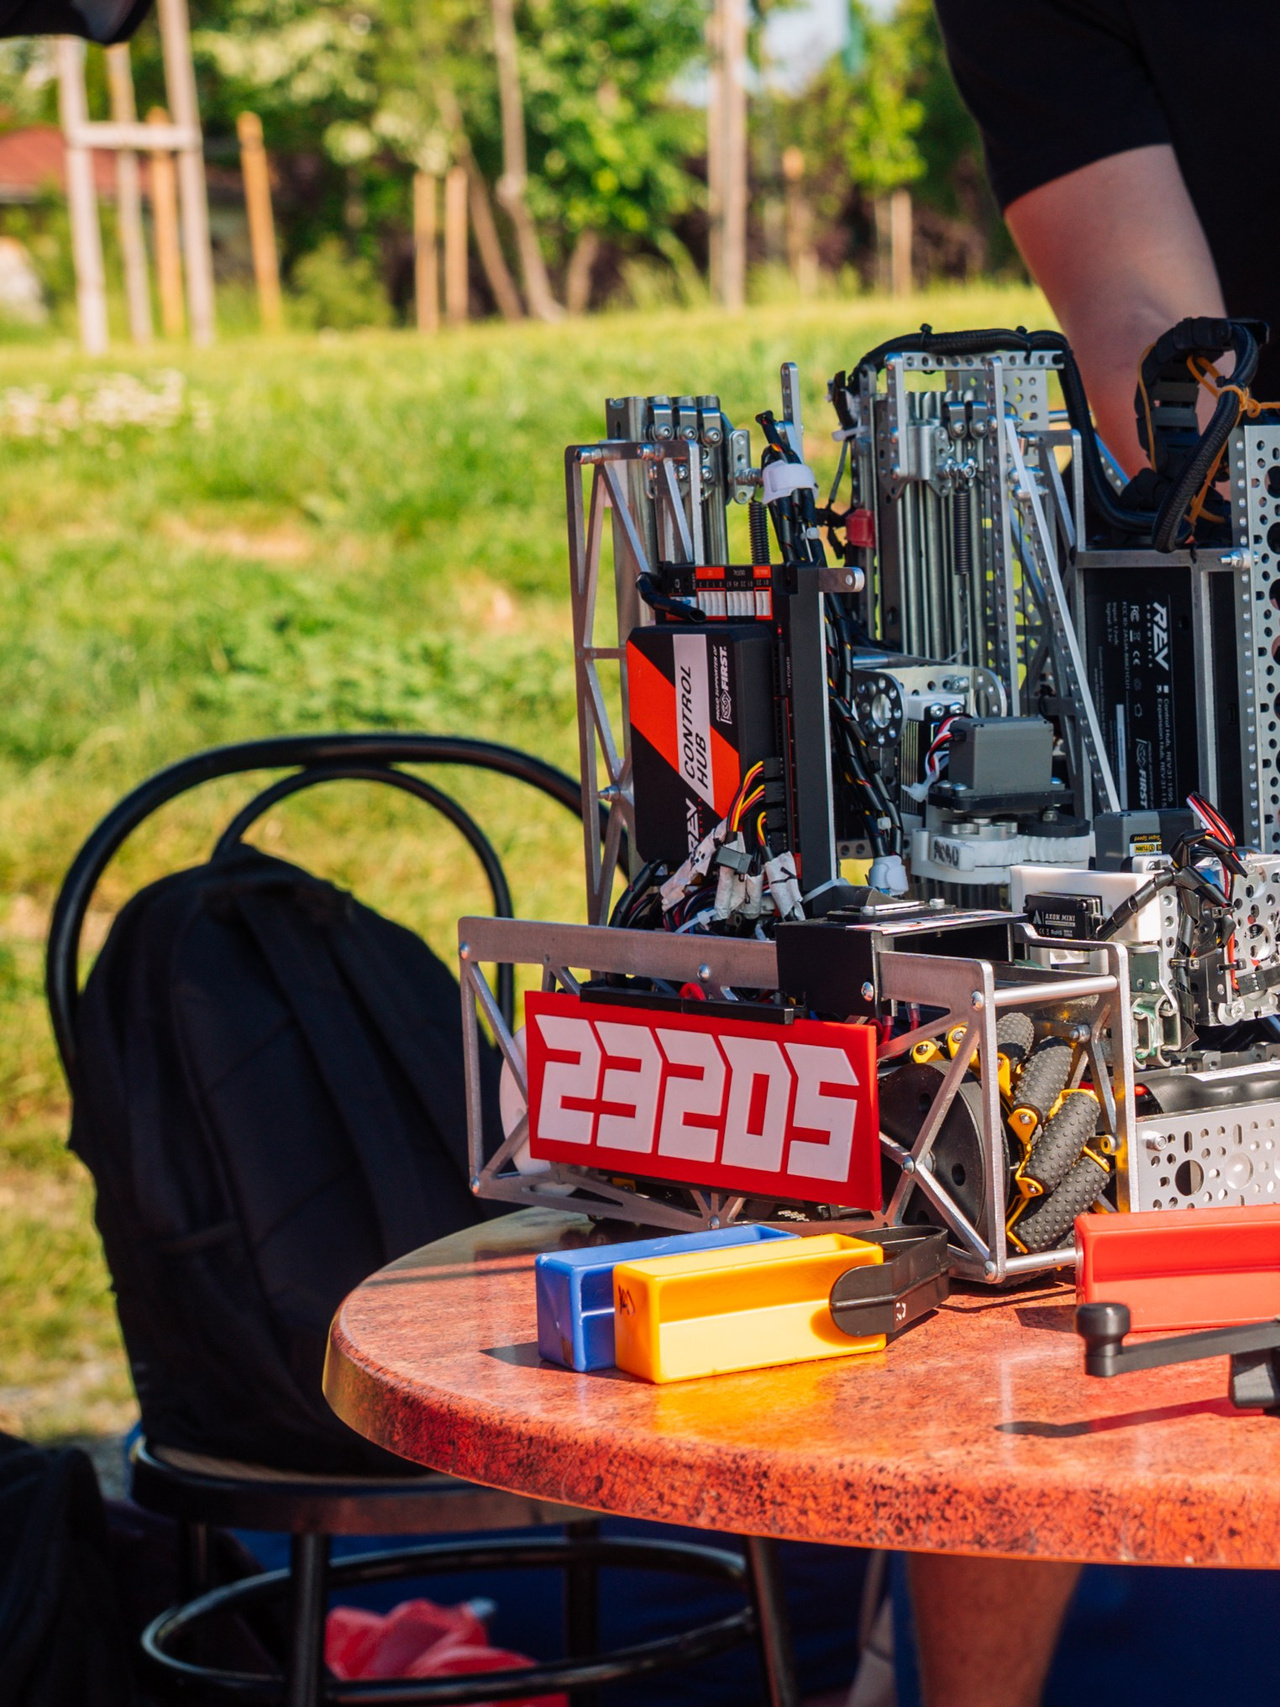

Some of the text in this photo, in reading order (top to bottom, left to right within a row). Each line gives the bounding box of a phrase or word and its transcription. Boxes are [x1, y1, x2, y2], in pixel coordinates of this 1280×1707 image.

[1152, 601, 1169, 671] REV
[682, 665, 695, 780] CONTROL
[696, 736, 709, 790] HUB
[1138, 769, 1148, 809] FIRST
[685, 797, 699, 854] REV
[534, 1013, 859, 1183] 23205
